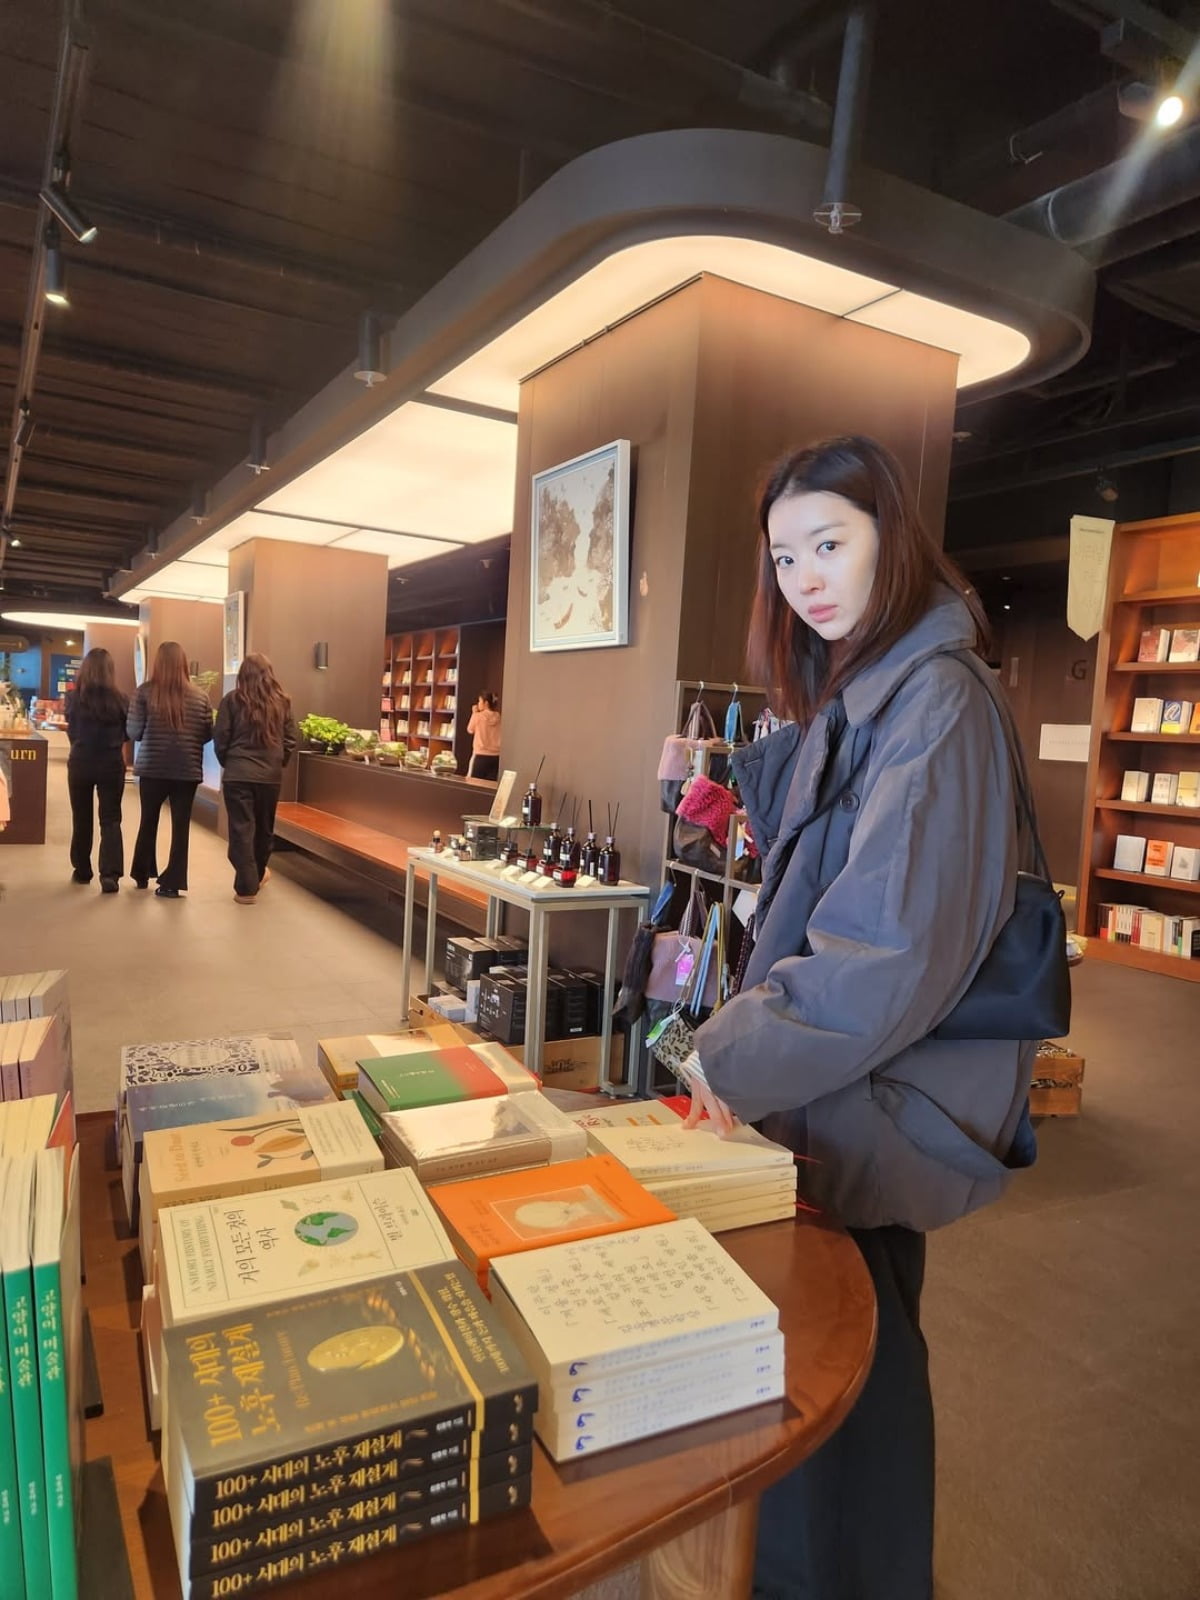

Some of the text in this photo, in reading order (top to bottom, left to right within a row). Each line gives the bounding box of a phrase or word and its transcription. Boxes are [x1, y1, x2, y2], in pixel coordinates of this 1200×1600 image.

[224, 1209, 258, 1284] 거의 모든 것의
[257, 1226, 277, 1251] 역사
[15, 1342, 33, 1387] 미술관
[43, 1335, 60, 1380] 미술관
[185, 1332, 244, 1448] 100+ 시대의
[222, 1323, 280, 1437] 노후 재설계
[211, 1460, 398, 1529] 100+ 시대의 노후 재설계
[215, 1475, 257, 1499] 100+
[261, 1461, 310, 1488] 시대의
[313, 1445, 351, 1470] 노후
[354, 1430, 402, 1458] 재설계
[210, 1491, 397, 1563] 100+ 시대의 노후 재설계
[210, 1523, 397, 1598] 100+ 시대의 노후 재설계
